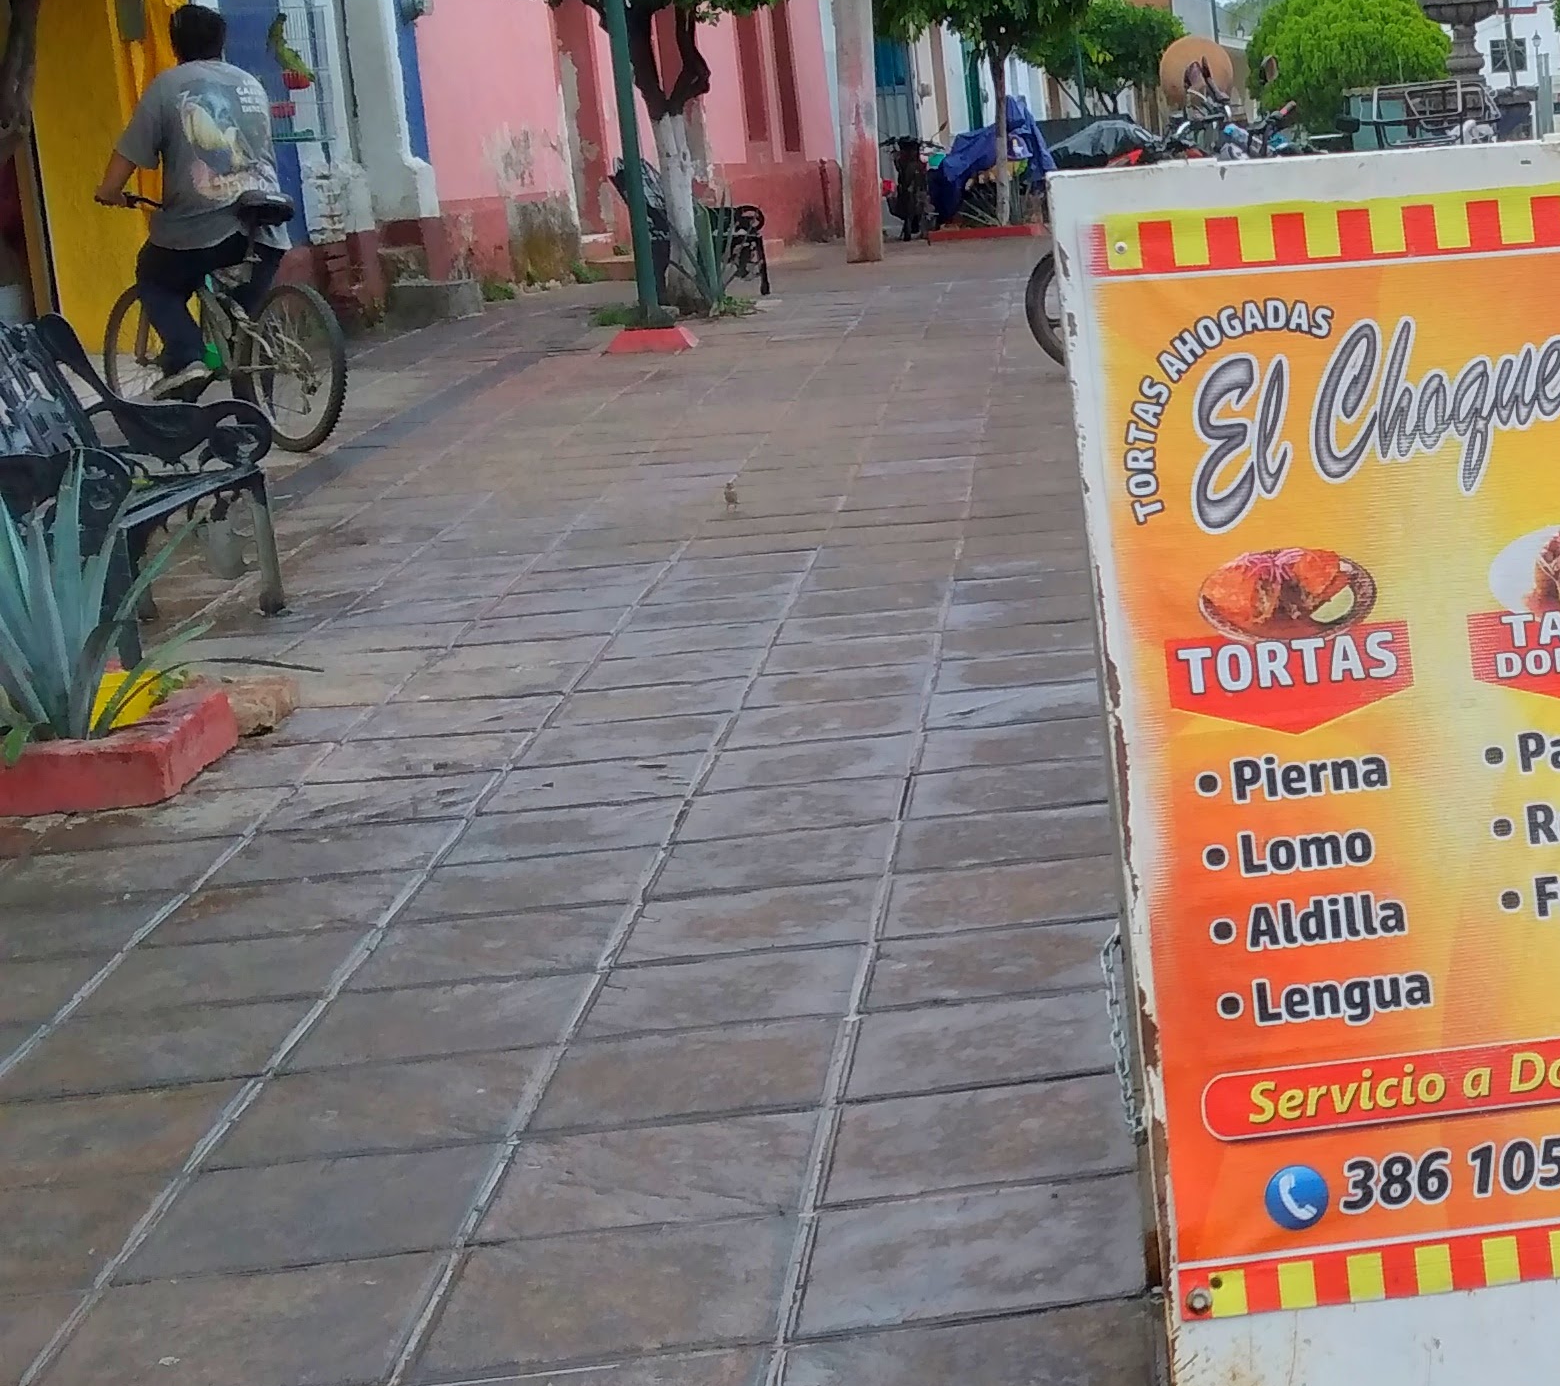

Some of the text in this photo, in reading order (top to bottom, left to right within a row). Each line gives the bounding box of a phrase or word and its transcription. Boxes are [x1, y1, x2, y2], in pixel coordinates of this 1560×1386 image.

[1124, 298, 1334, 525] TORTAS AHOGADAS
[1192, 352, 1289, 533] El
[1177, 631, 1399, 695] TORTAS
[1231, 755, 1389, 802] Pierna
[1239, 828, 1374, 875] Lomo
[1248, 895, 1406, 951] Aldilla
[1253, 971, 1431, 1025] Lengua
[1249, 1064, 1447, 1125] Servicio
[1462, 1064, 1492, 1101] a
[1339, 1151, 1450, 1213] 386
